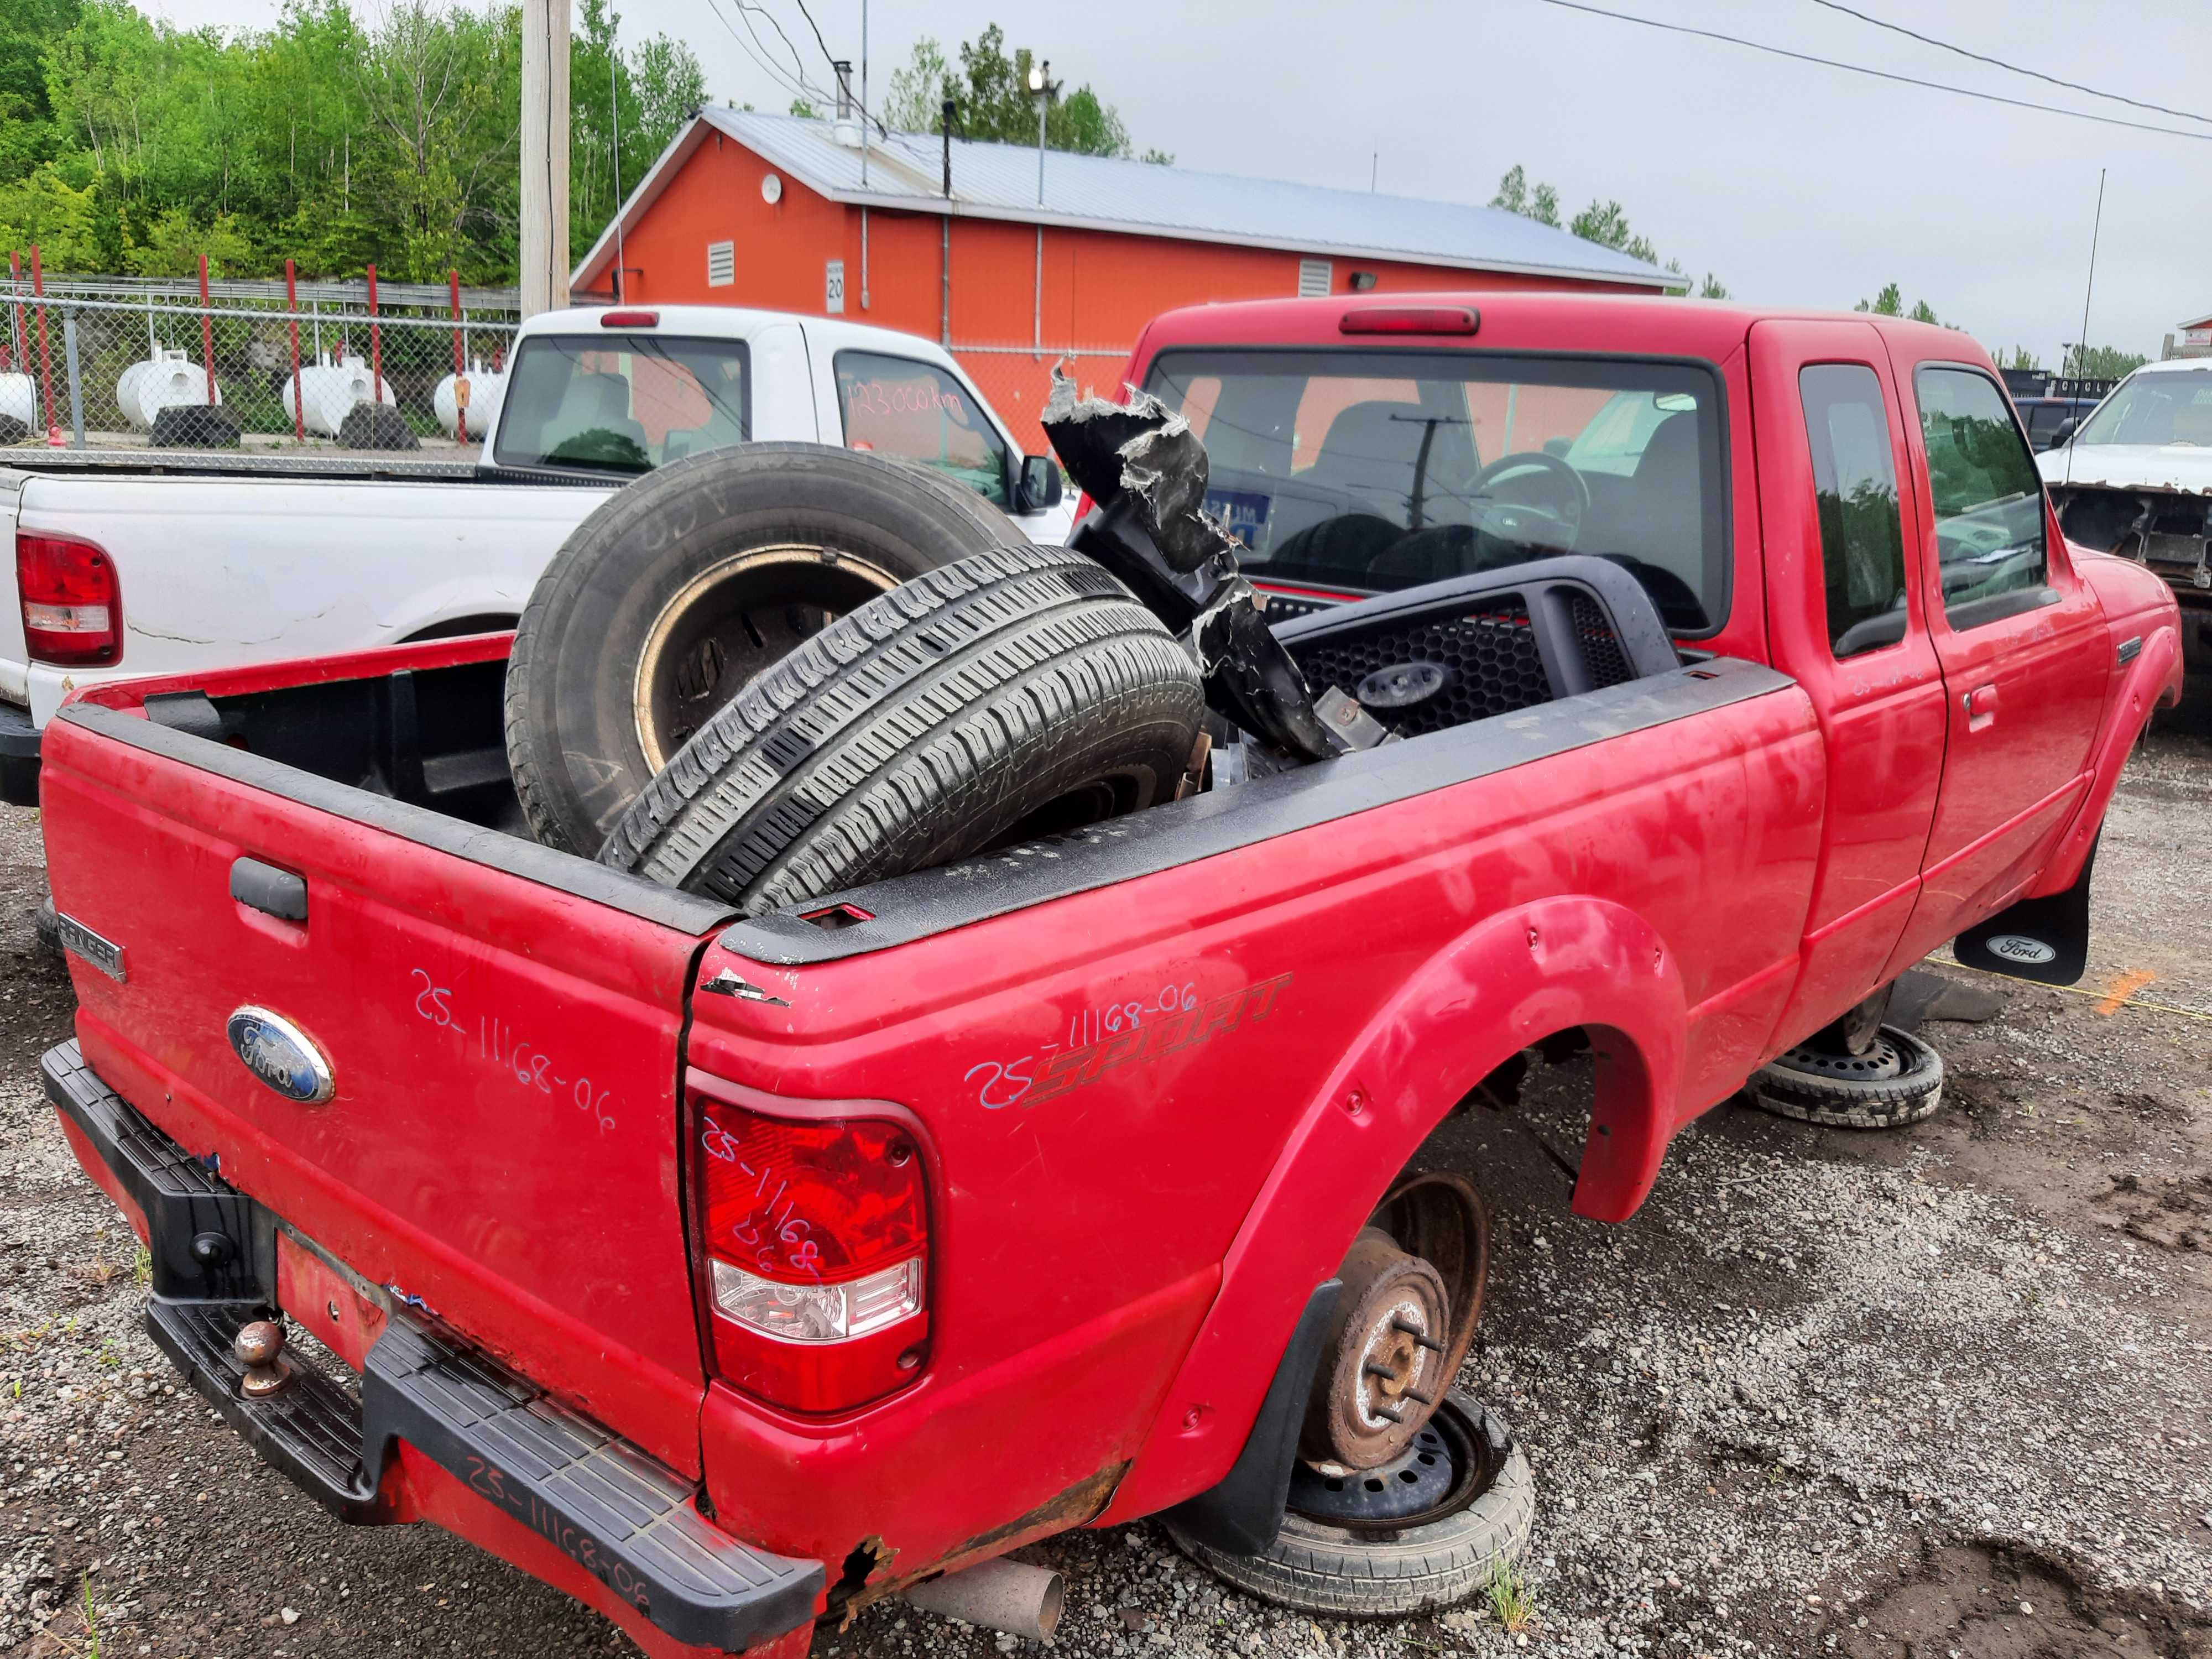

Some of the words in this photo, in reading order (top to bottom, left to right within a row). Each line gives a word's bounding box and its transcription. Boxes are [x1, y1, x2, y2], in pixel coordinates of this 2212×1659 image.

[828, 278, 843, 298] 20
[59, 919, 116, 969] RANGER
[2000, 938, 2042, 959] Ford
[240, 1026, 293, 1089] Ford
[411, 967, 615, 1136] 25-11168-06
[1021, 971, 1293, 1108] SPORT
